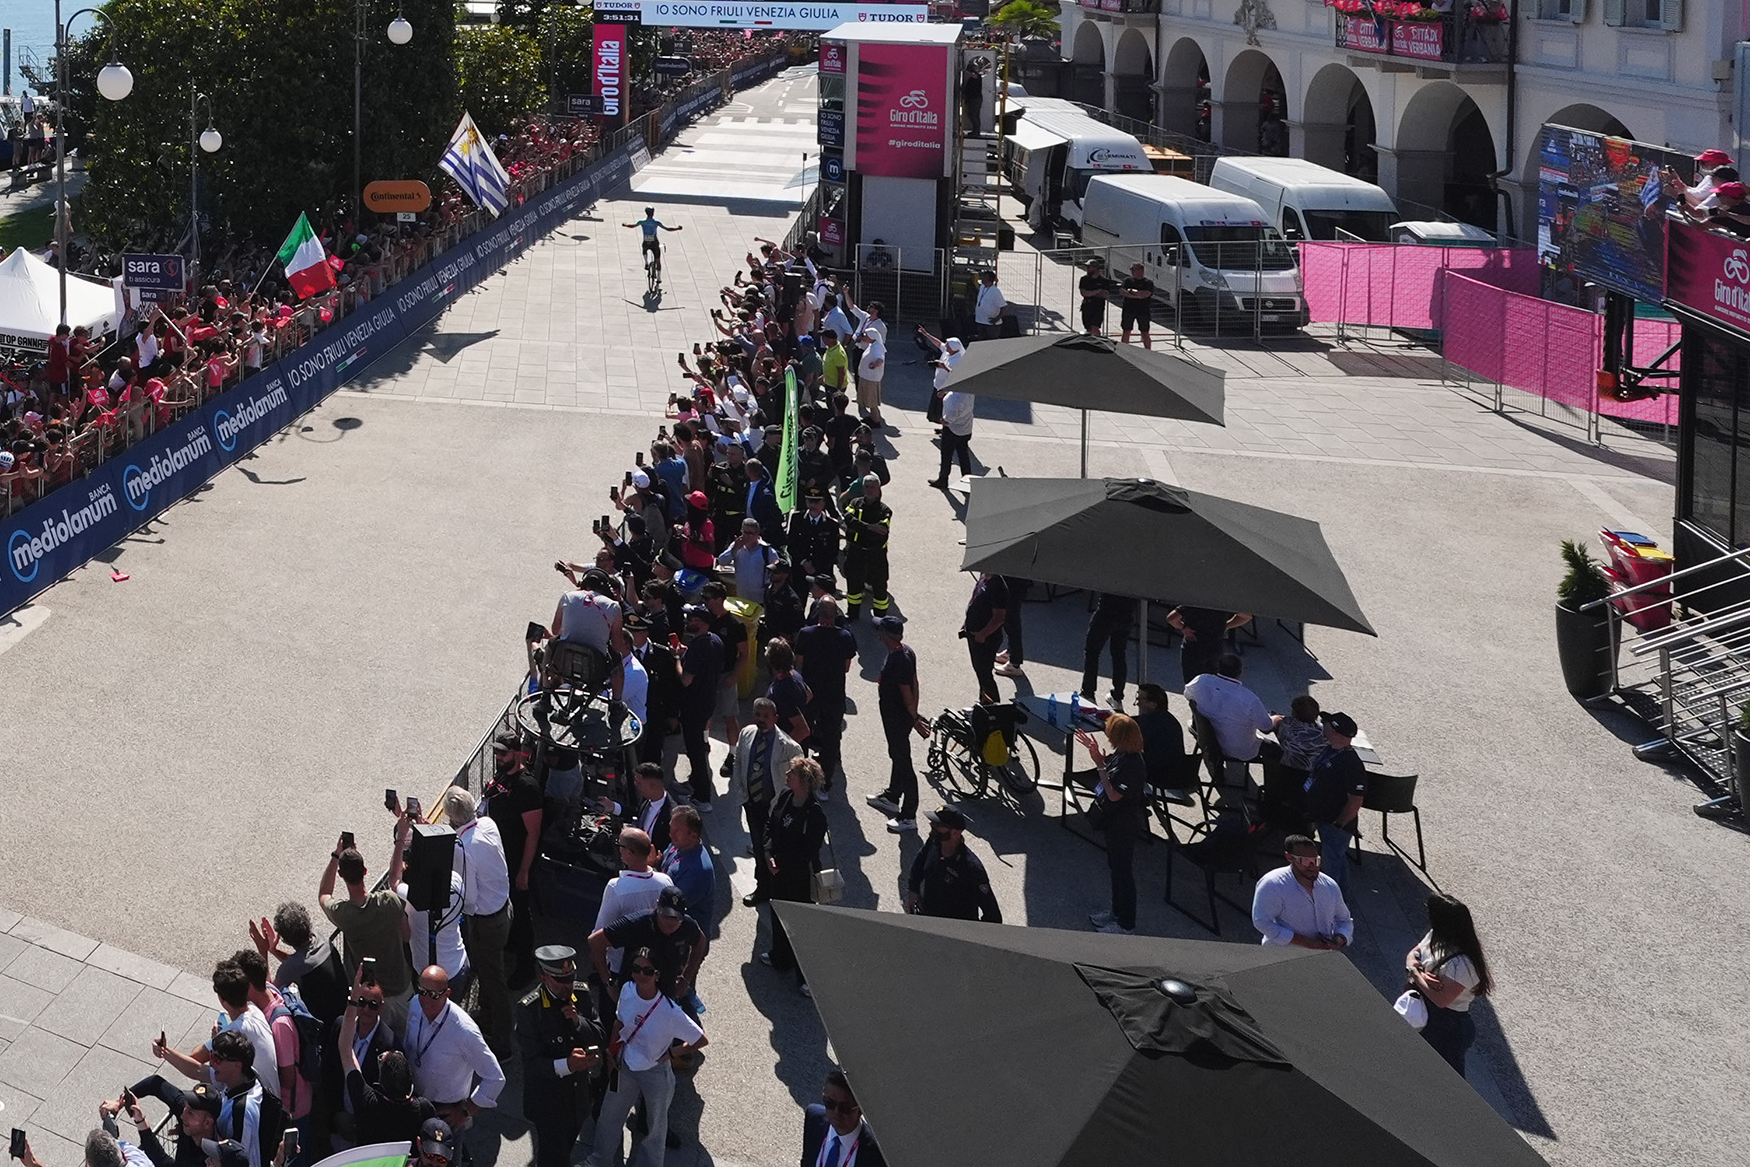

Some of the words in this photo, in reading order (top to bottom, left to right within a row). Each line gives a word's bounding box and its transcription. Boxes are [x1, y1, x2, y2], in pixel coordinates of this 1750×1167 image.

[656, 4, 669, 15] IO
[672, 5, 707, 16] SONO
[711, 6, 743, 17] FRIULI
[746, 6, 796, 18] VENEZIA
[799, 8, 840, 19] GIULIA
[869, 14, 914, 22] TUDOR
[597, 40, 620, 85] d'Italia
[571, 98, 591, 106] sara
[890, 109, 908, 122] Giro
[909, 110, 938, 124] d'Italia
[888, 139, 941, 149] #giroditalia
[370, 192, 414, 202] Continental
[128, 260, 160, 273] sara
[134, 276, 160, 284] assicura
[141, 291, 157, 299] sara
[396, 298, 406, 314] IO
[404, 286, 424, 308] SONO
[436, 262, 461, 284] VENEZIA
[1714, 278, 1730, 305] Giro
[2, 334, 17, 345] TOP
[18, 336, 43, 348] GANNA
[288, 369, 301, 388] IO
[298, 352, 326, 382] SONO
[323, 338, 348, 364] FRIULI
[343, 320, 376, 347] VENEZIA
[372, 306, 397, 332] GIULIA
[266, 378, 282, 391] BANCA
[218, 386, 288, 442] mediolanum
[187, 425, 206, 442] BANCA
[127, 434, 212, 500] mediolanum
[88, 482, 112, 502] BANCA
[12, 491, 118, 570] mediolanum
